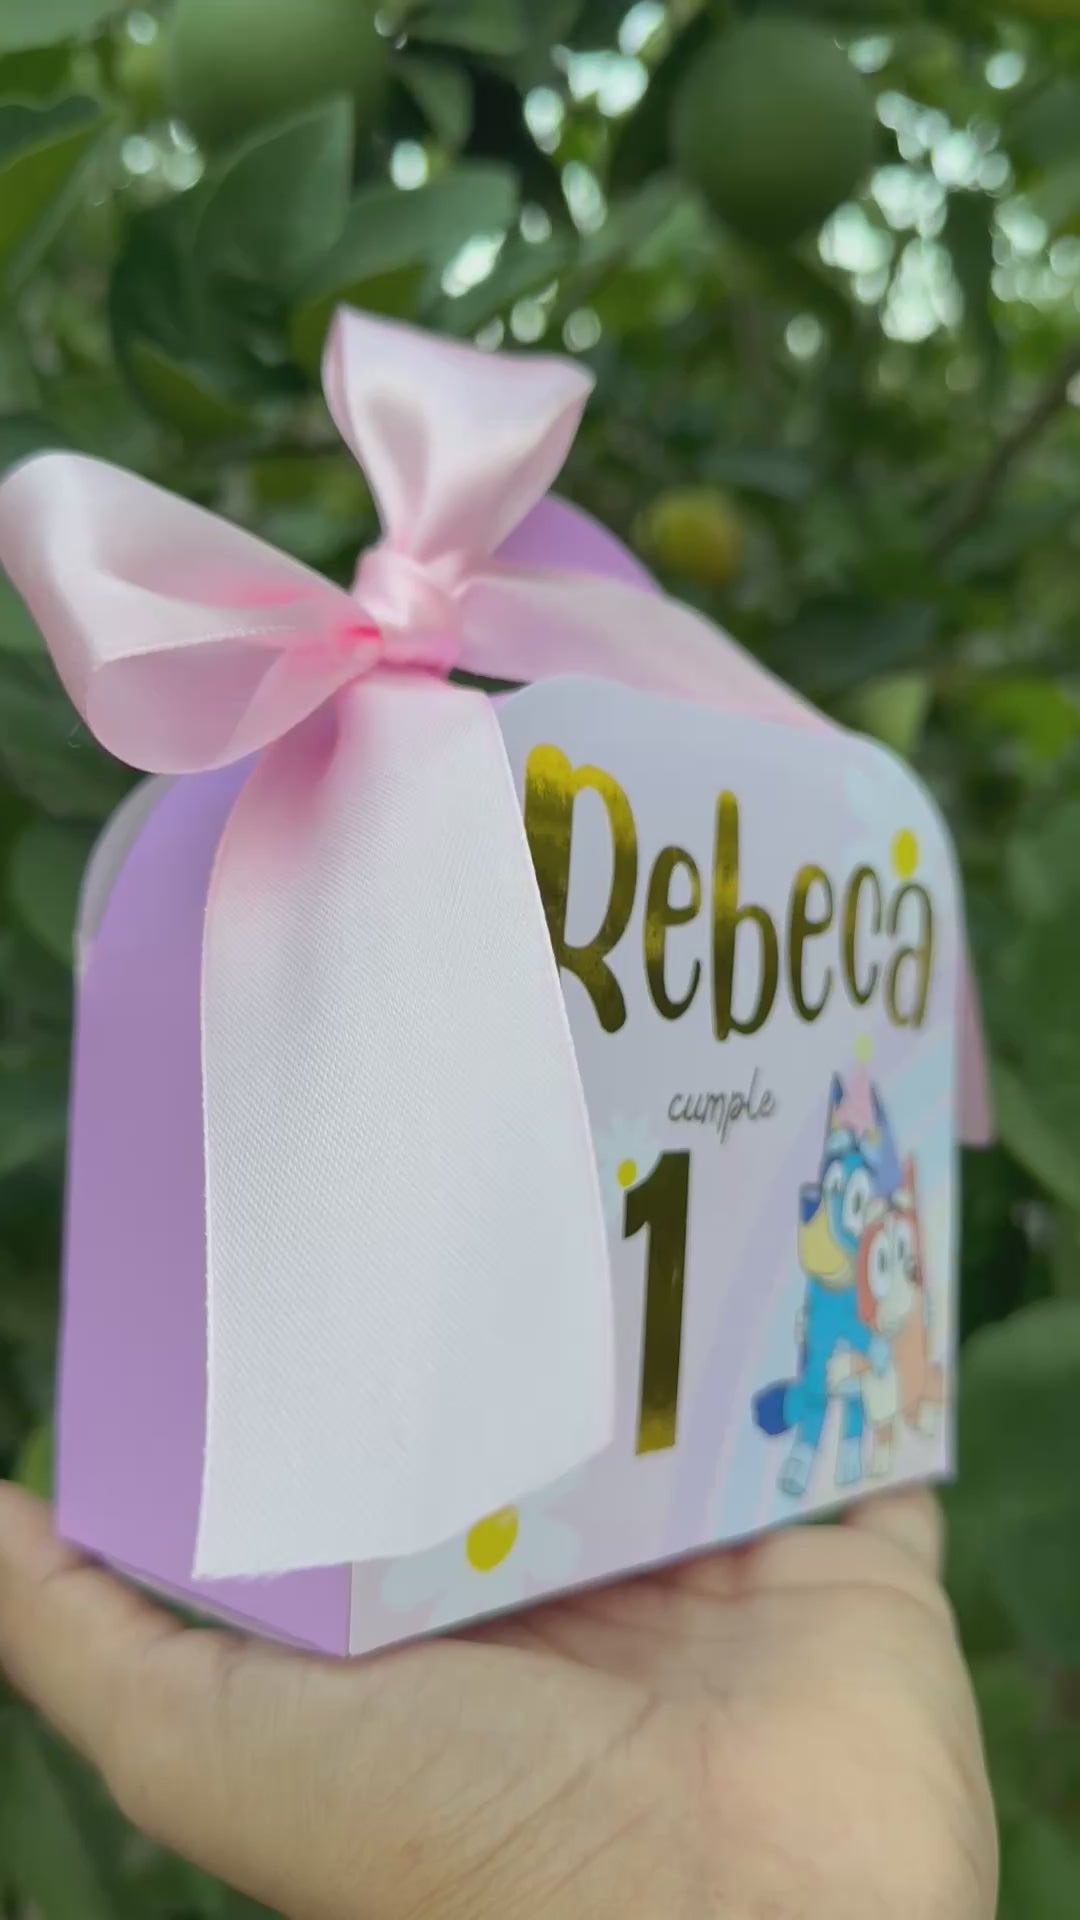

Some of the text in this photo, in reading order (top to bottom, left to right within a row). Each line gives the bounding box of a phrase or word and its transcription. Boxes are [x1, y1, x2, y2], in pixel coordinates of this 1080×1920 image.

[524, 742, 934, 1042] Rebeca
[667, 1066, 777, 1144] cumple
[622, 1147, 691, 1457] 1
